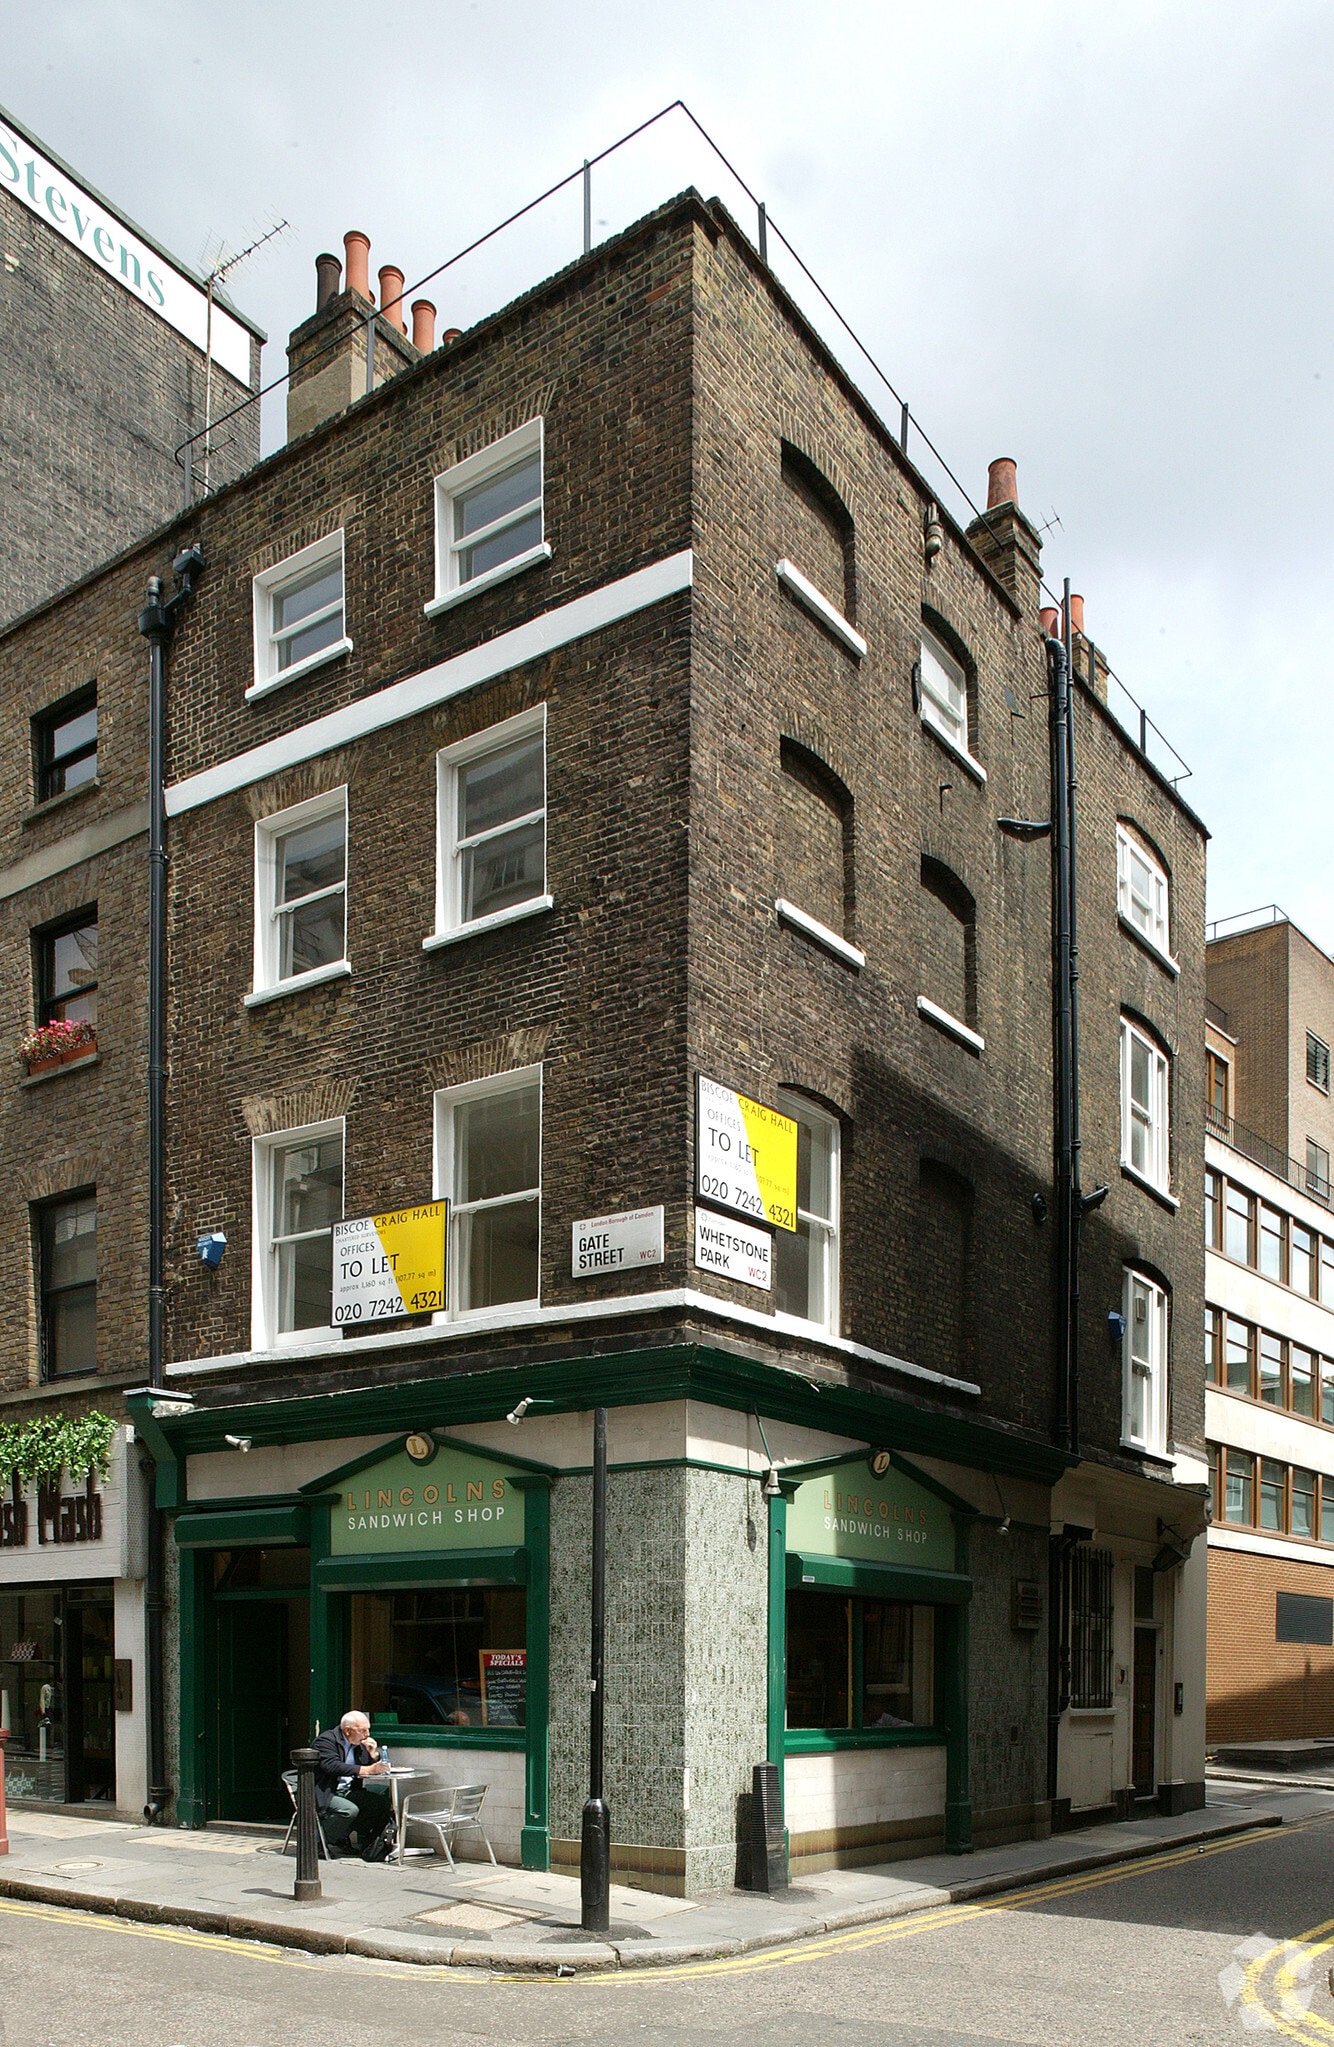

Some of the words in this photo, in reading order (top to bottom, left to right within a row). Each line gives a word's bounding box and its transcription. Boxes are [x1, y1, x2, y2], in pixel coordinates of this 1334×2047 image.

[0, 126, 165, 306] Stevens
[701, 1079, 733, 1104] BISCOE
[738, 1098, 767, 1121] CRAIG
[770, 1112, 793, 1134] HALL
[707, 1108, 741, 1131] OFFICES
[708, 1126, 731, 1152] TO
[738, 1140, 759, 1167] LET
[701, 1174, 729, 1200] 020
[735, 1187, 764, 1216] 7242
[768, 1203, 794, 1228] 4321
[335, 1220, 369, 1237] BISCOE
[374, 1212, 408, 1228] CRAIG
[412, 1206, 441, 1221] HALL
[340, 1241, 375, 1257] OFFICES
[579, 1233, 610, 1252] GATE
[639, 1249, 657, 1260] WC2
[699, 1225, 769, 1262] WHETSTONE
[340, 1260, 363, 1280] TO
[372, 1253, 400, 1275] LET
[579, 1247, 625, 1269] STREET
[700, 1246, 730, 1269] PARK
[748, 1266, 767, 1281] WC2
[335, 1303, 362, 1322] 020
[369, 1296, 404, 1317] 7242
[410, 1290, 442, 1310] 4321
[409, 1438, 424, 1456] L
[876, 1455, 887, 1472] L
[0, 1466, 26, 1547] sh
[347, 1478, 505, 1511] LINCOLNS
[823, 1490, 928, 1526] LINCOLNS
[348, 1510, 443, 1530] SANDWICH
[454, 1506, 505, 1523] SHOP
[824, 1516, 890, 1539] SANDWICH
[897, 1527, 928, 1544] SHOP
